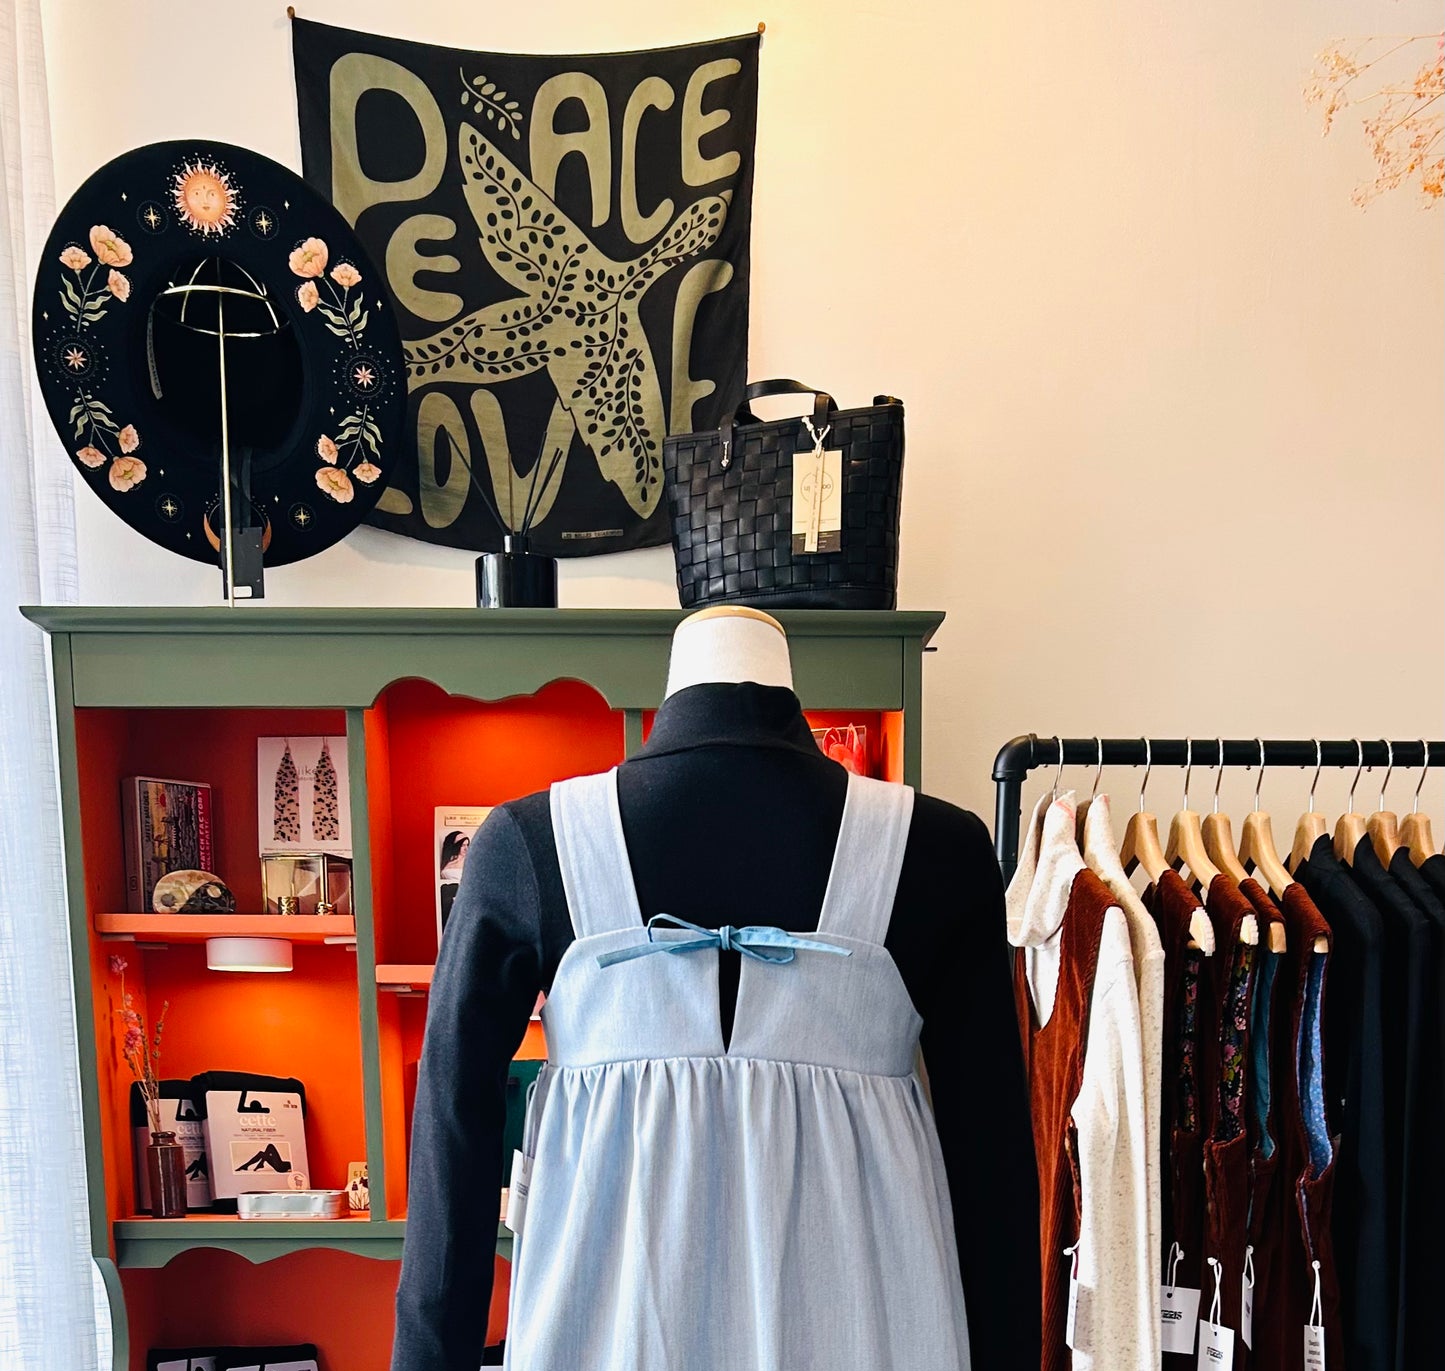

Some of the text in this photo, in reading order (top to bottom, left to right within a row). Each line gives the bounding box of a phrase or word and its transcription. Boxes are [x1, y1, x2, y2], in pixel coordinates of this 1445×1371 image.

[197, 789, 207, 870] MATCH FACTORY
[239, 1114, 277, 1127] cette
